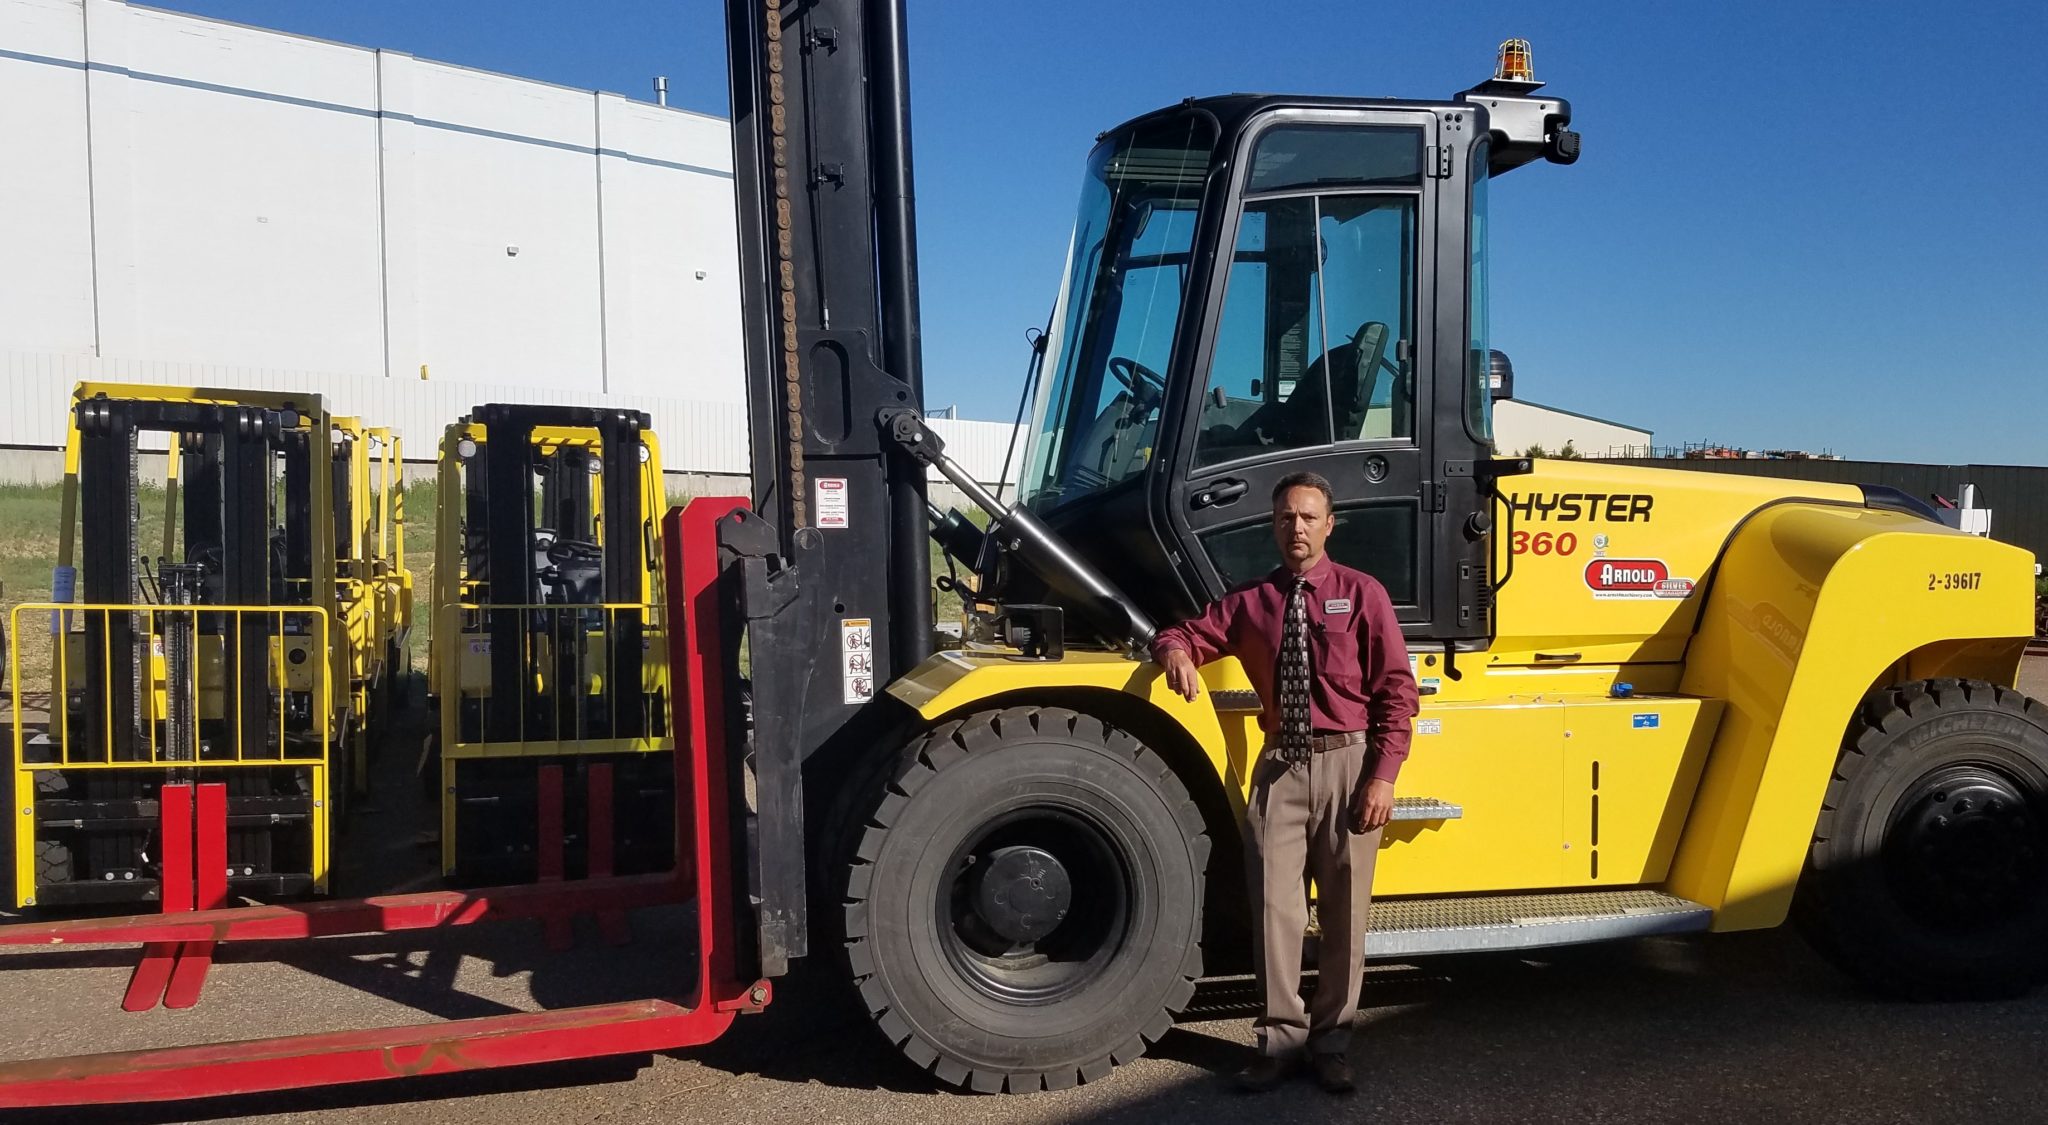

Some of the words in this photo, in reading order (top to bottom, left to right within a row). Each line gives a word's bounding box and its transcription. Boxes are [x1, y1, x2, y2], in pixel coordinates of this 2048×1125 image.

[1511, 493, 1654, 522] HYSTER
[1512, 531, 1577, 556] 360
[1600, 563, 1655, 585] ARNOLD
[1928, 572, 1982, 590] 2-39617
